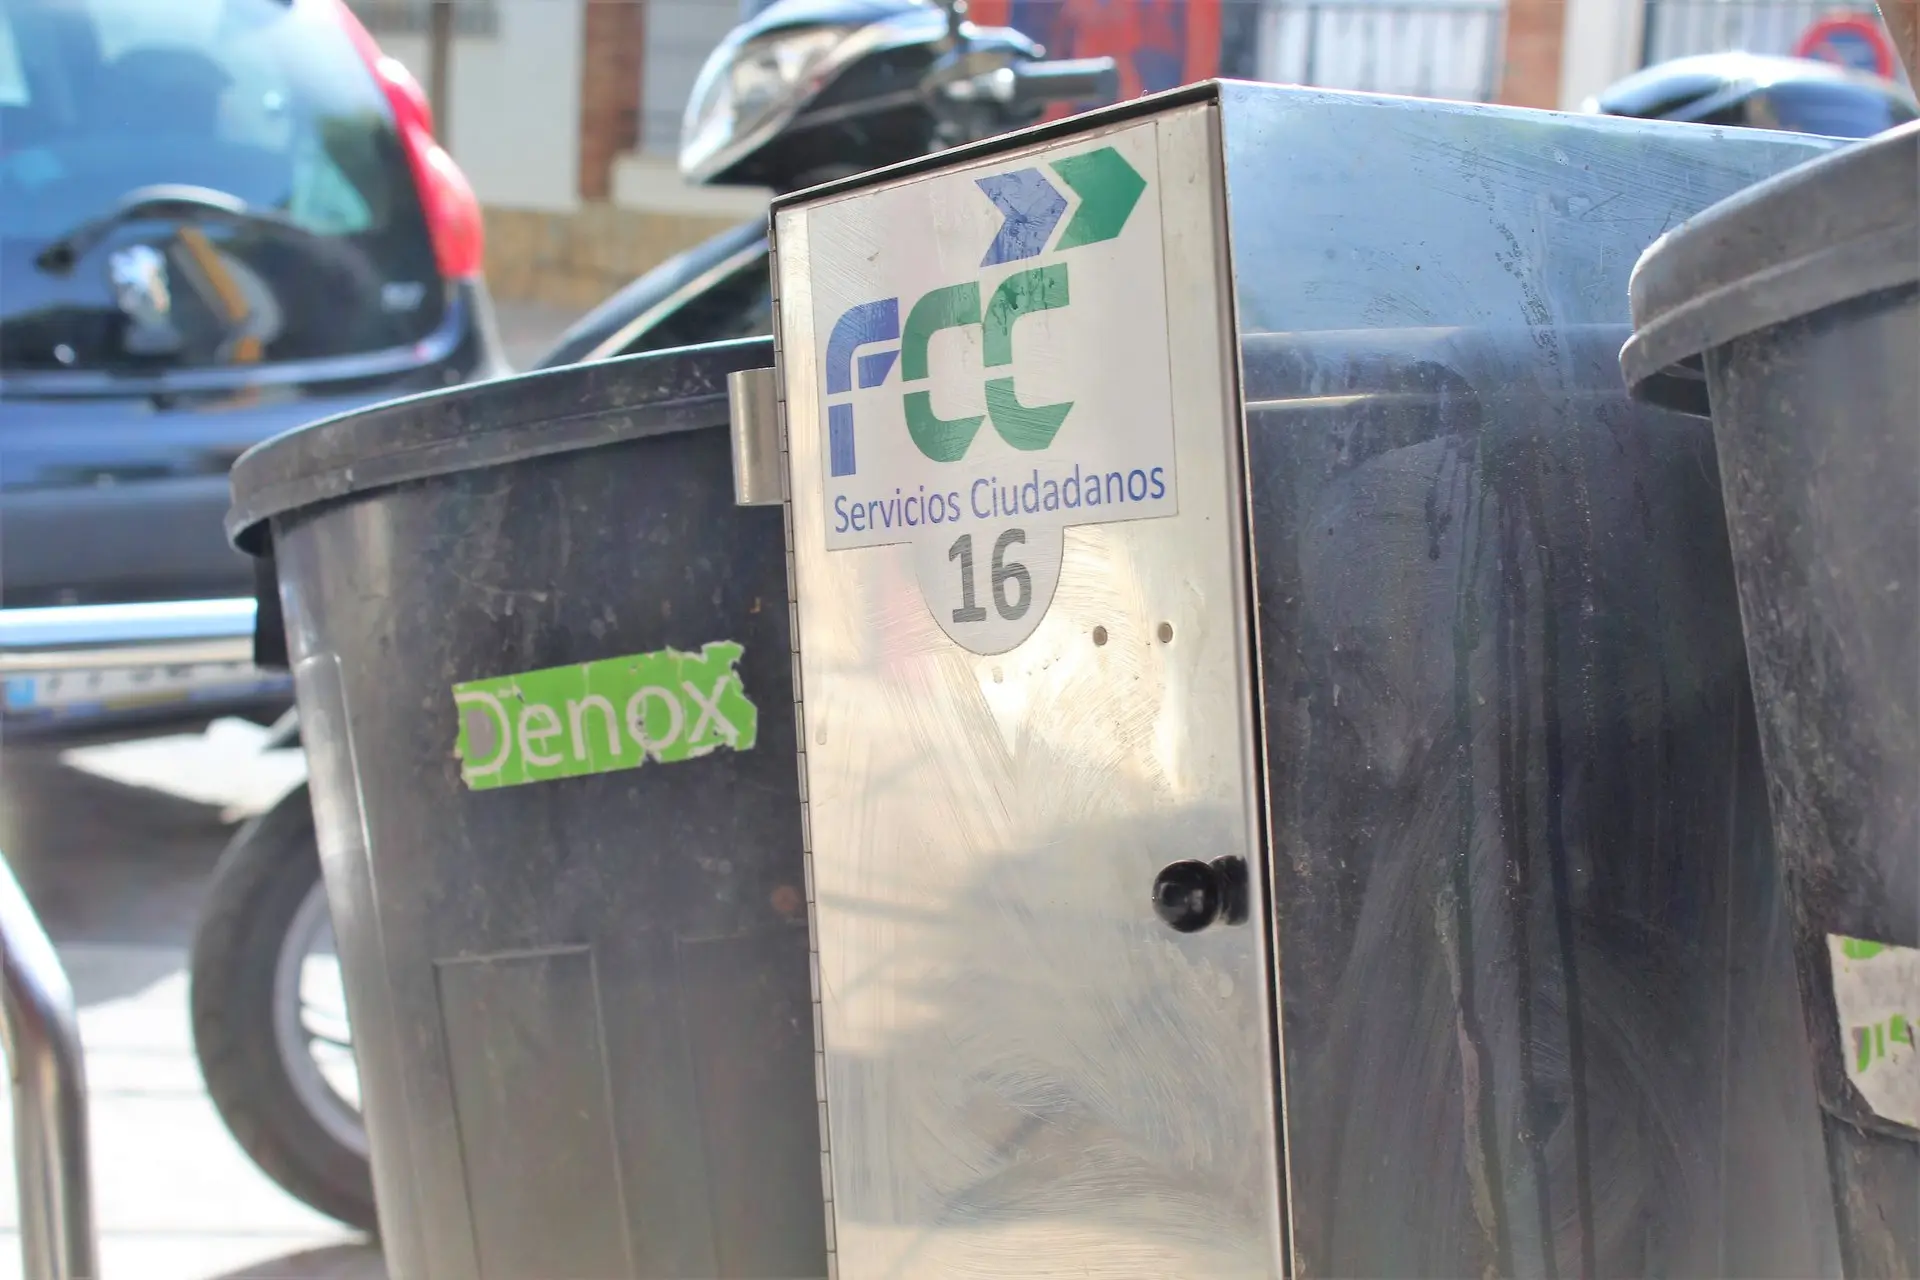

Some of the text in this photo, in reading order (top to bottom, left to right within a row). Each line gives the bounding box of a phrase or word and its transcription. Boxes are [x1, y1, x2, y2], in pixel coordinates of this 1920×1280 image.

[834, 464, 1165, 534] Servicios Ciudadanos
[948, 528, 1032, 624] 16
